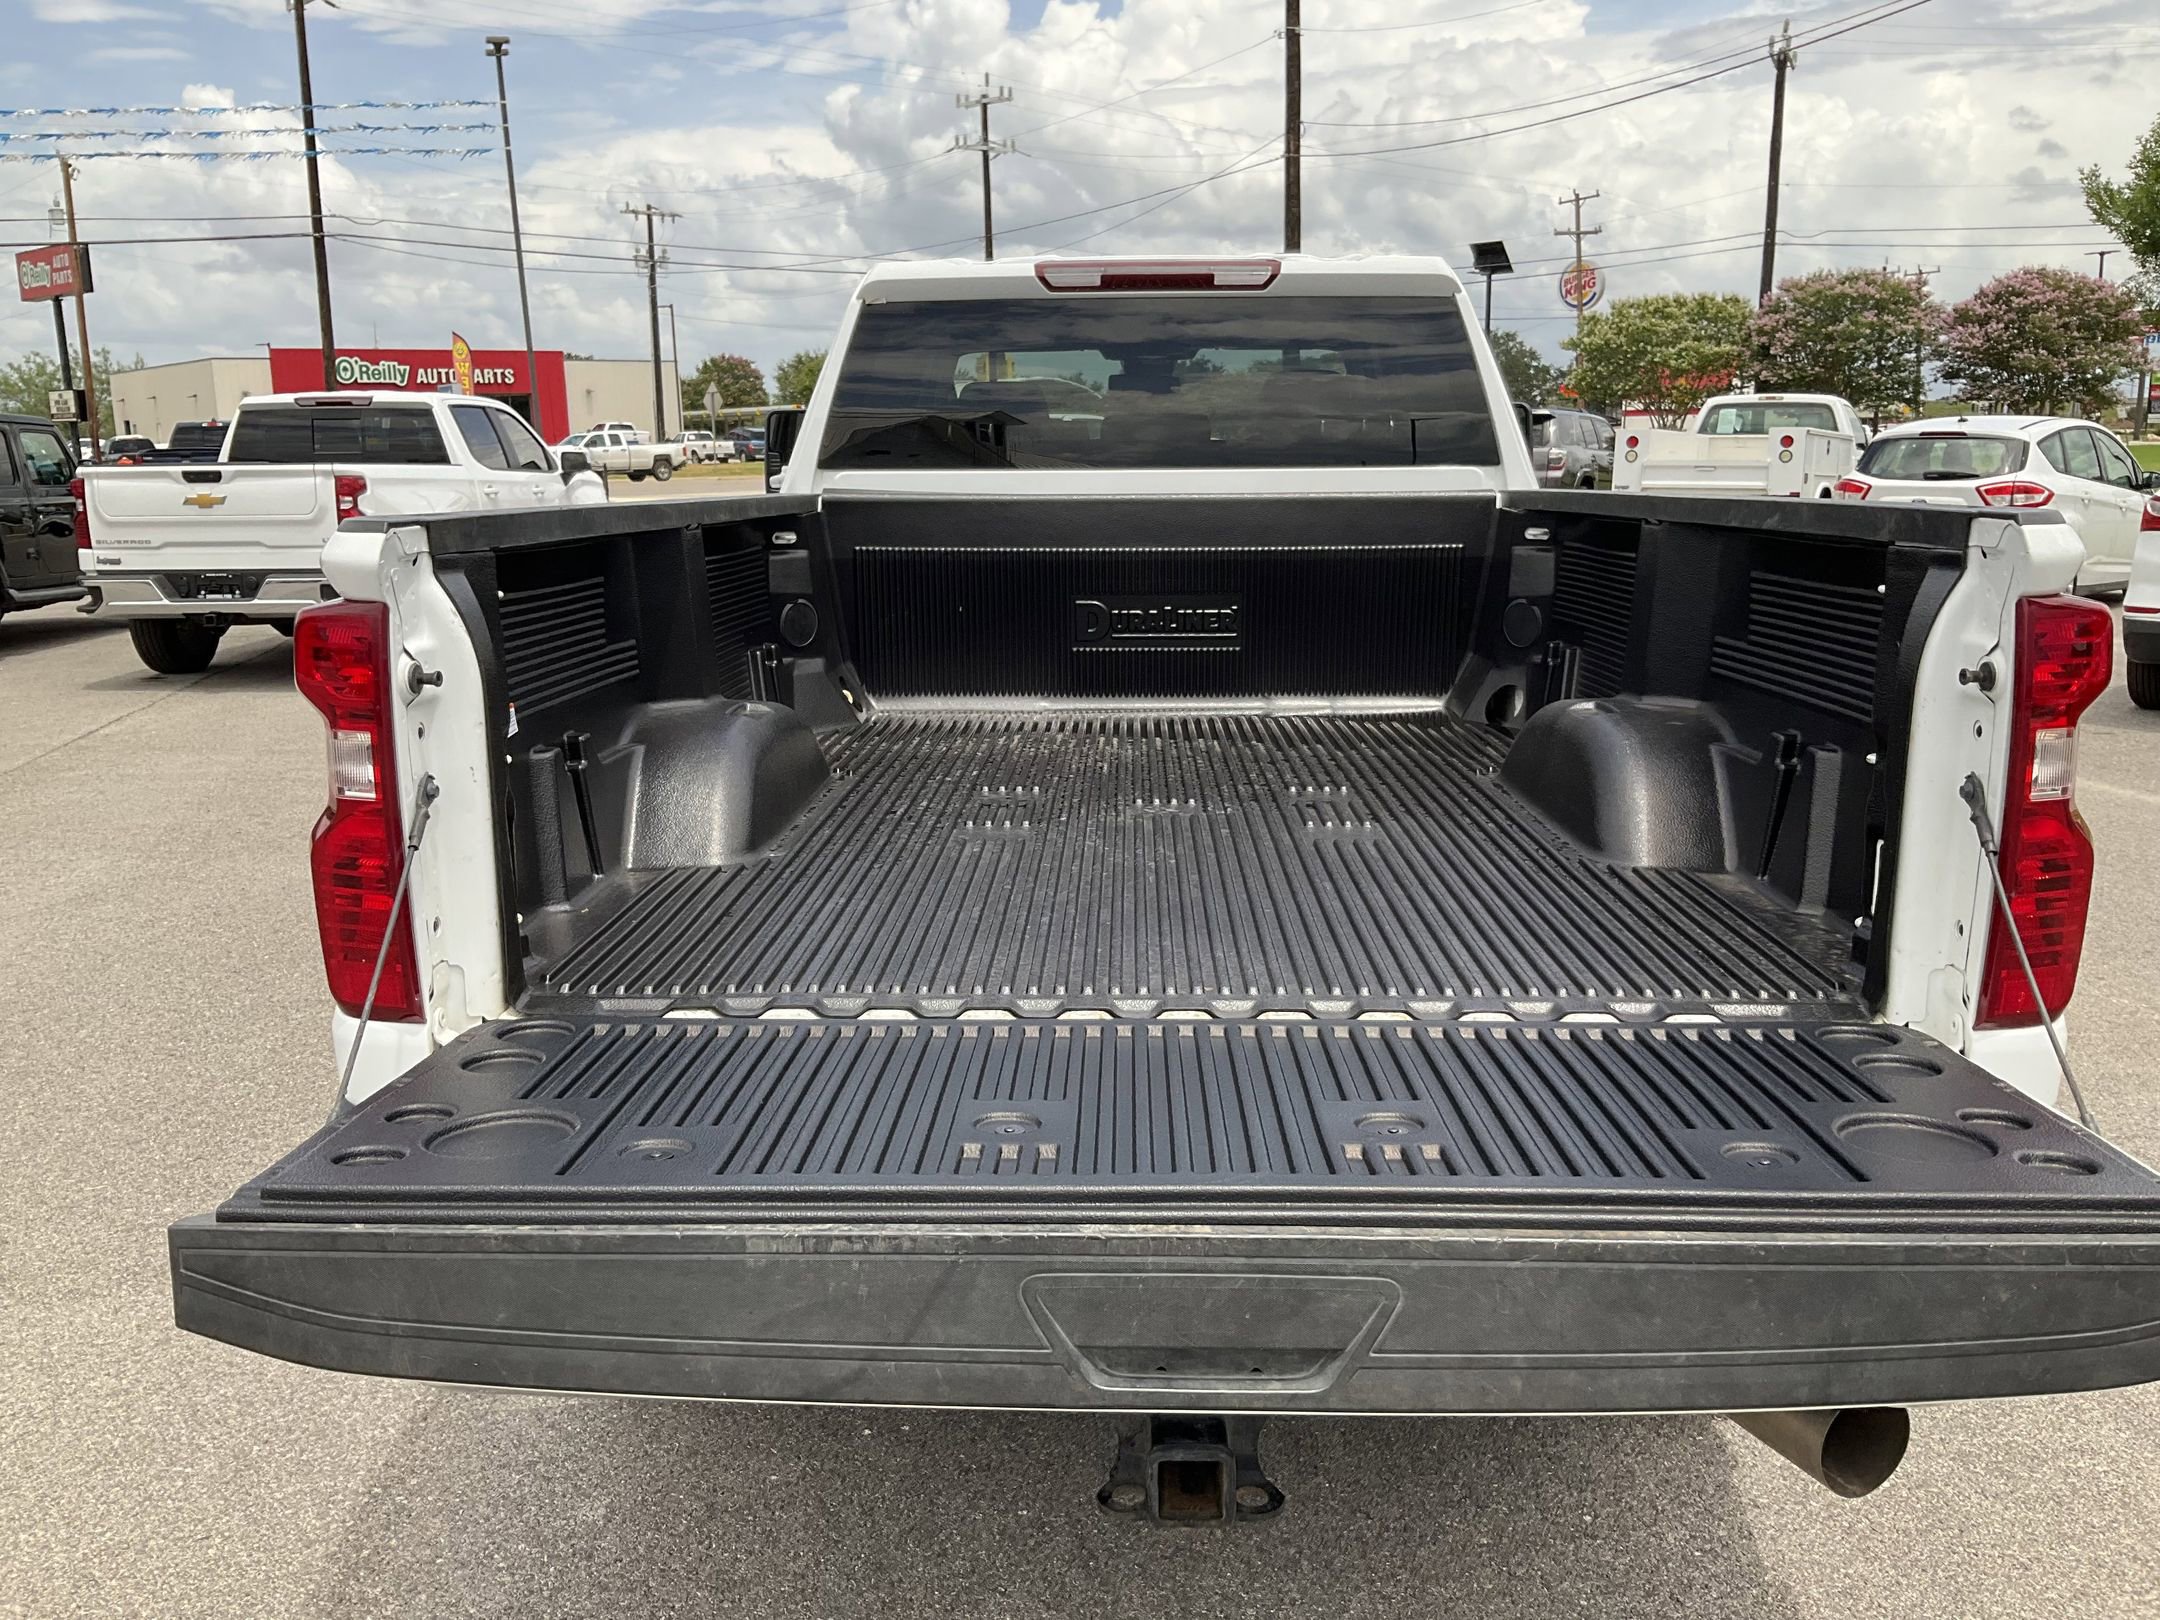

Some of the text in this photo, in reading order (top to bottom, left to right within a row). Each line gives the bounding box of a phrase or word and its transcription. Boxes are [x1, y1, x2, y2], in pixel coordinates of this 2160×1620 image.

[336, 357, 514, 386] O'Reilly AUTO ARTS
